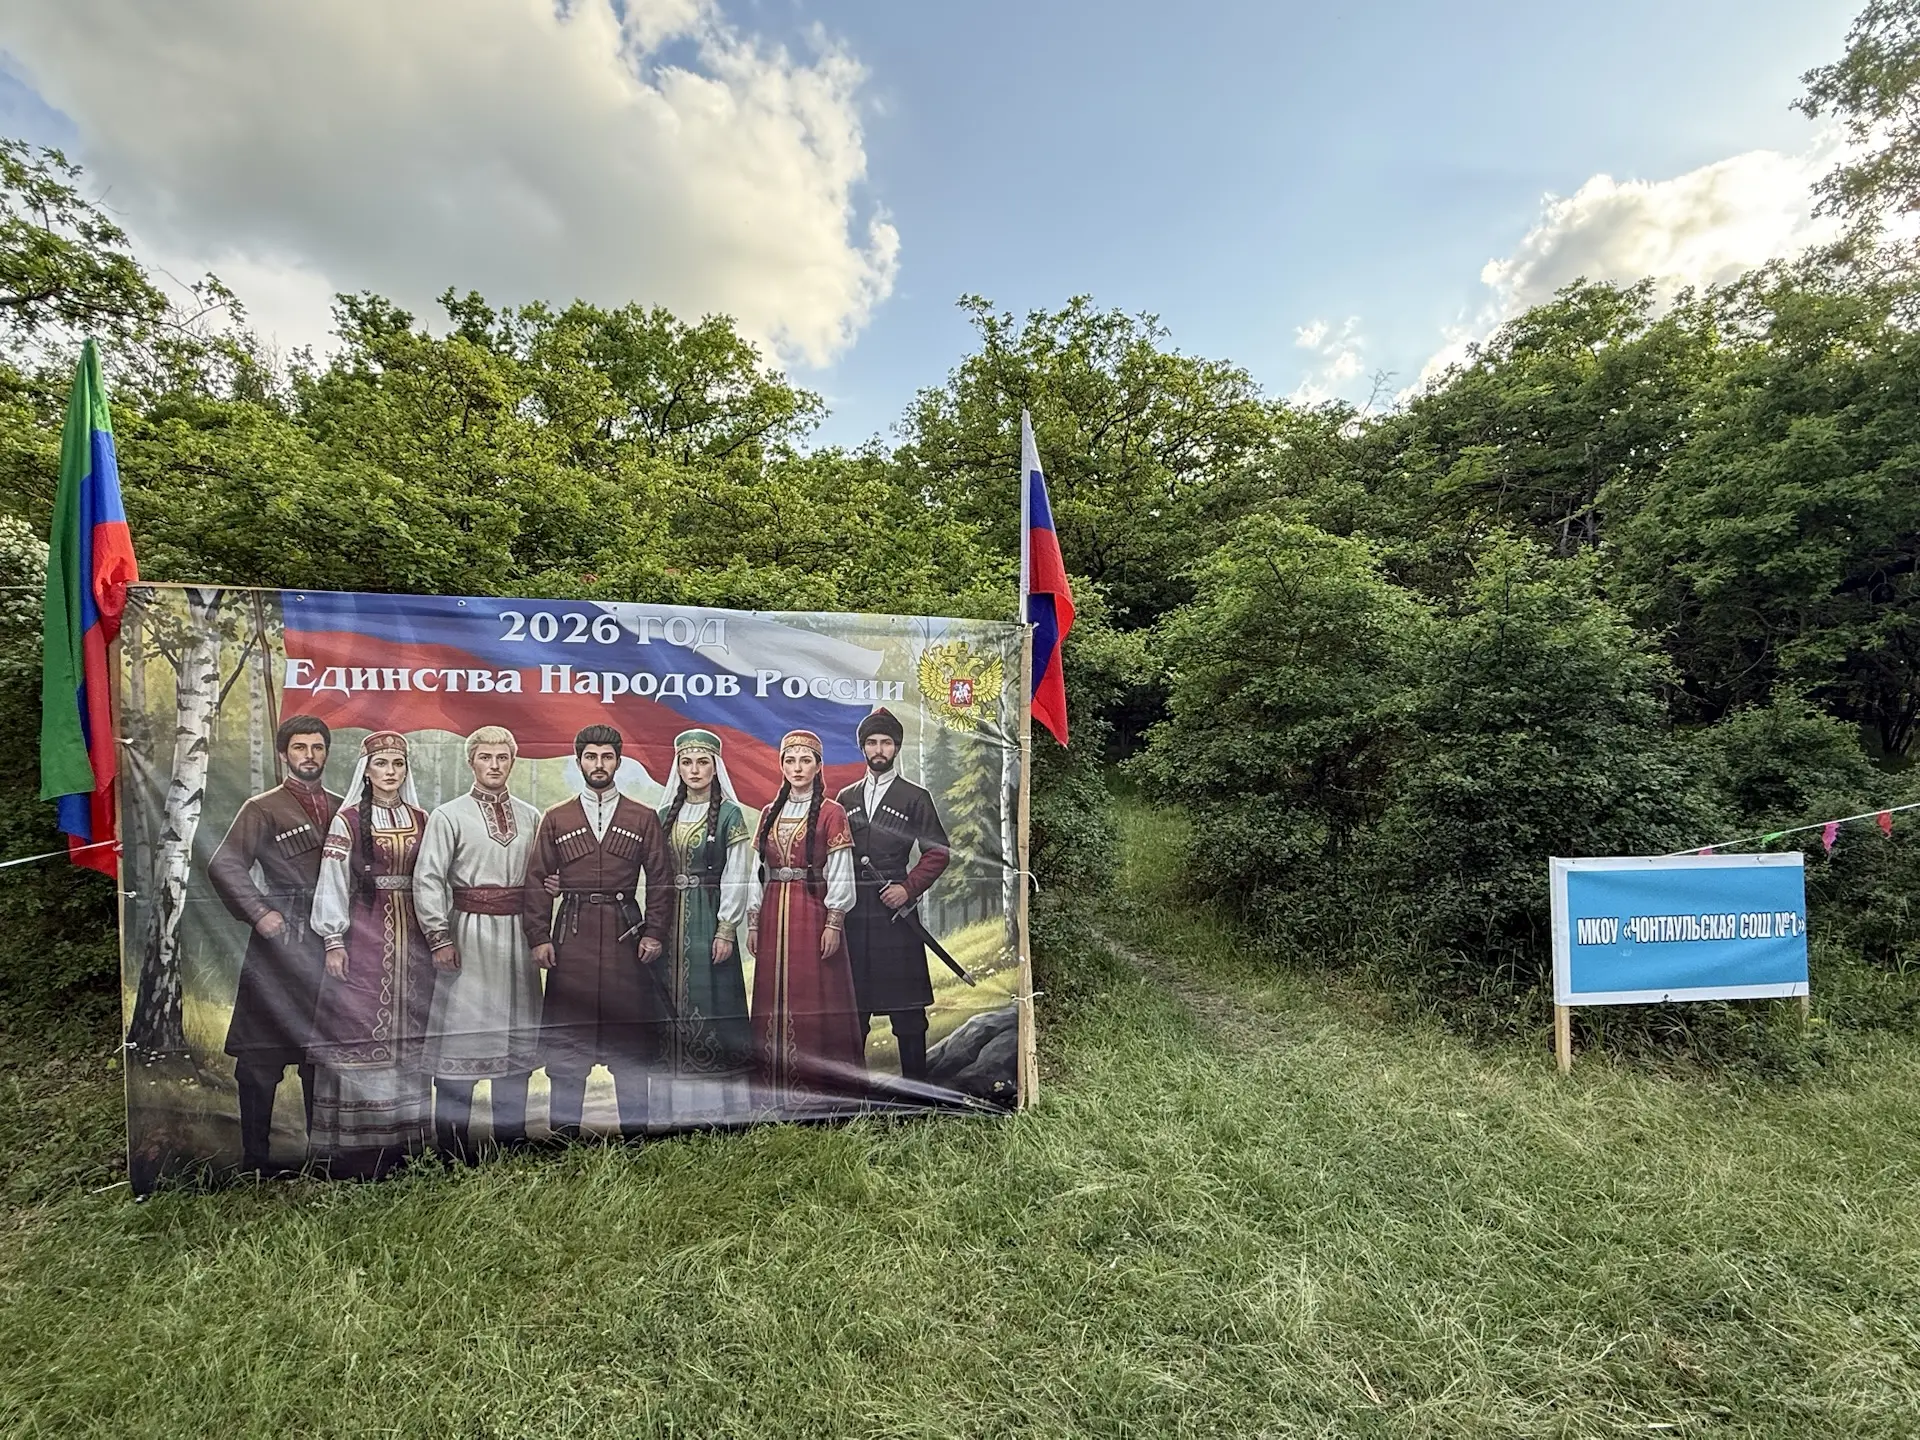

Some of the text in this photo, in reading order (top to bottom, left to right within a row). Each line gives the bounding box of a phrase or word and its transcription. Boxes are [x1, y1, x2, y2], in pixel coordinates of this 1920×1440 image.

[498, 611, 730, 655] 2026 ГОД
[283, 658, 905, 704] Единства Народов России
[1577, 911, 1805, 945] МКОУ «ЧОНТАУЛЬСКАЯ СОШ №1»
